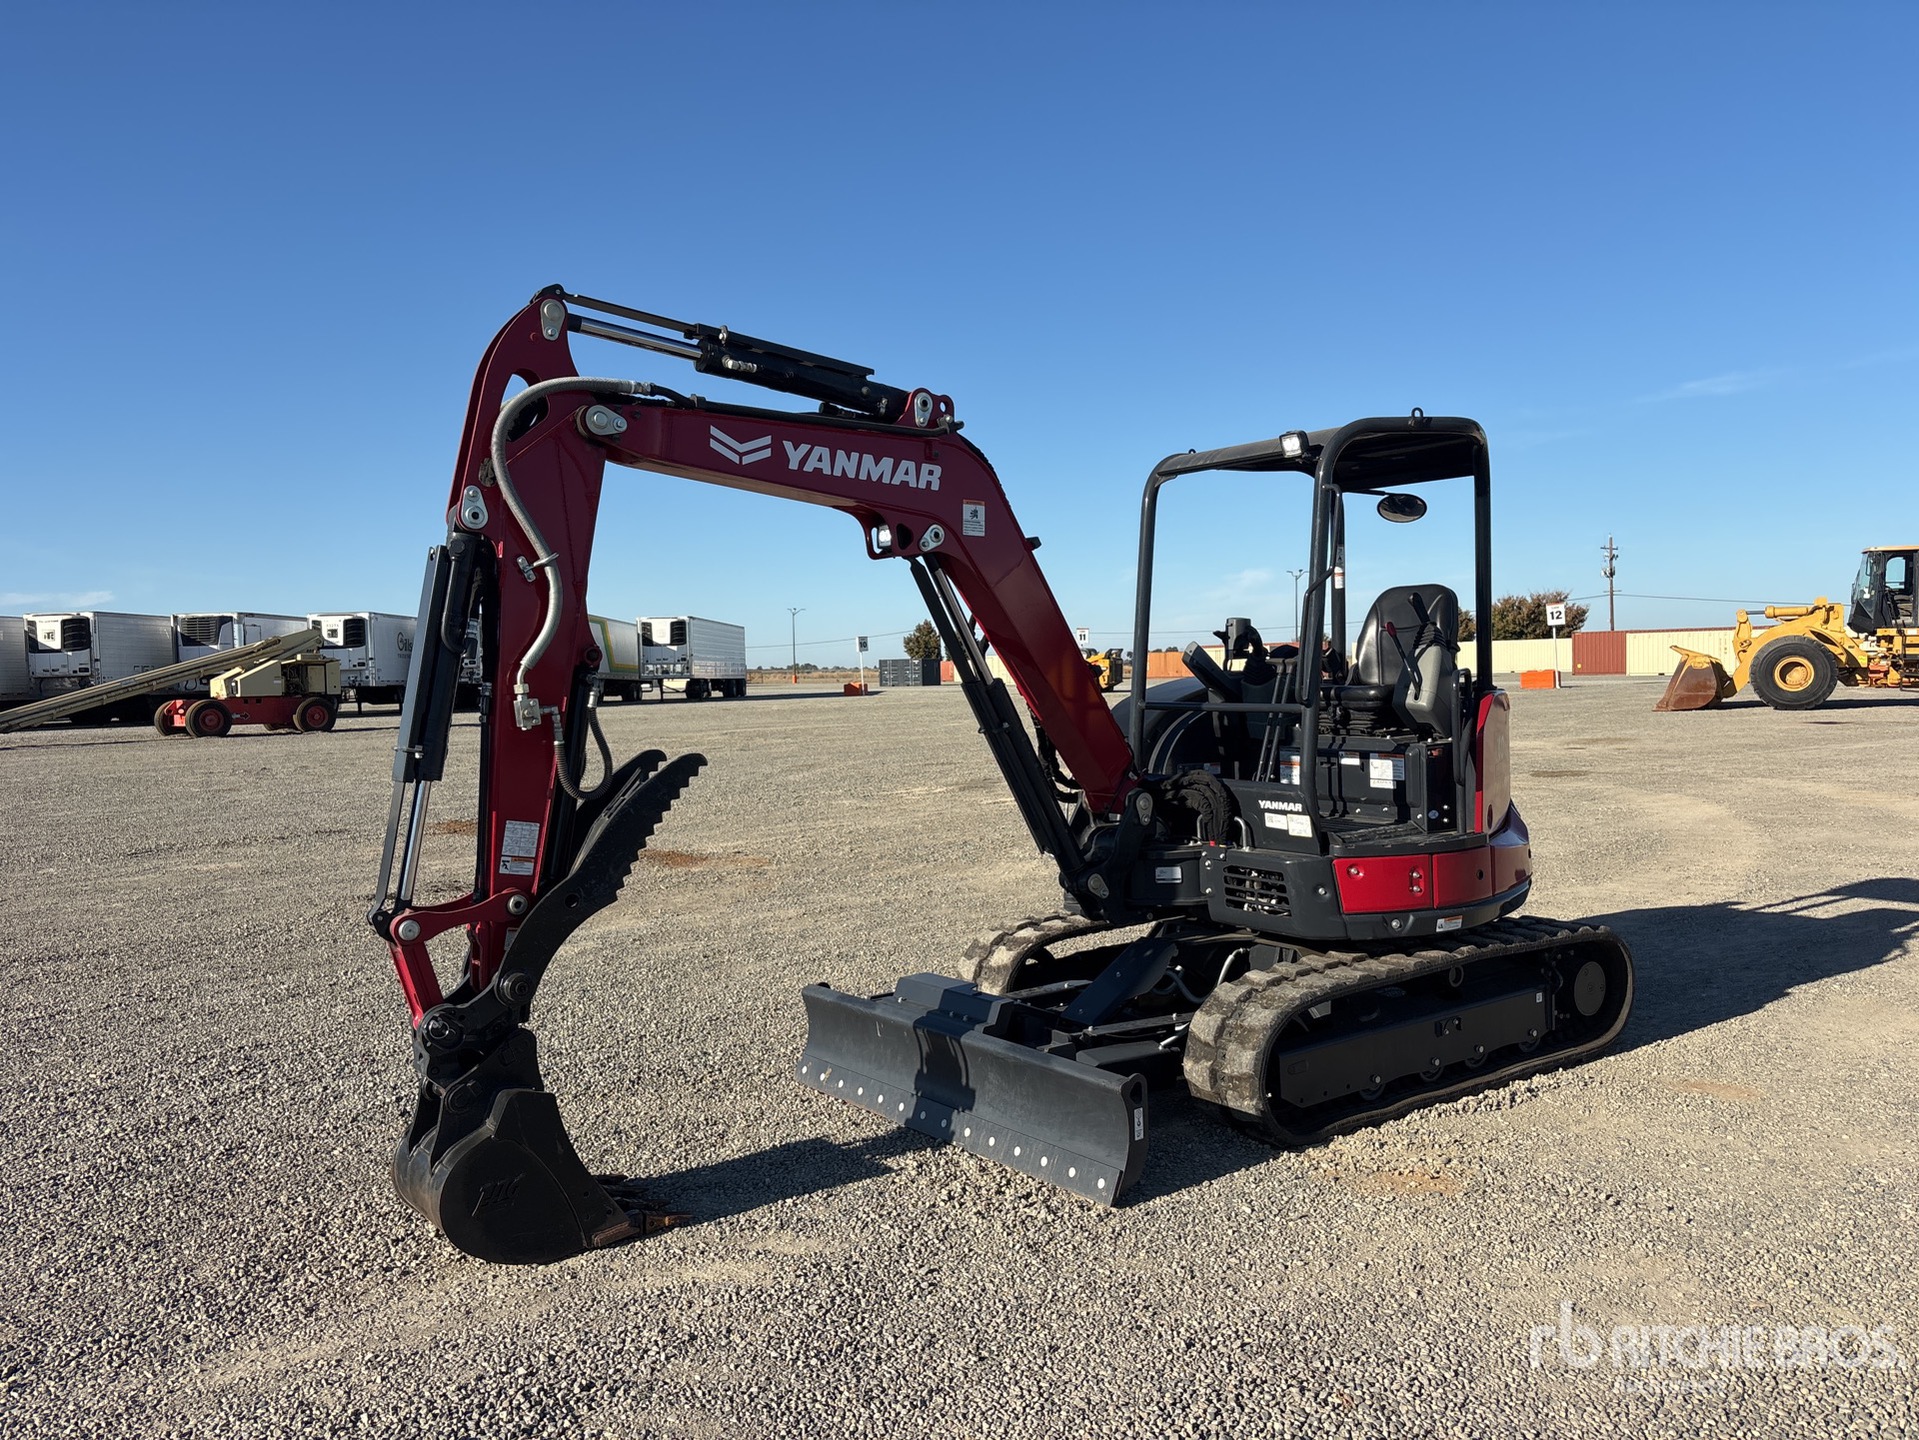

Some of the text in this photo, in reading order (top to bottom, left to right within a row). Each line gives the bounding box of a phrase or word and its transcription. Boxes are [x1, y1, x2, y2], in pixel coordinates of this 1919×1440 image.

[782, 440, 943, 491] YANMAR
[1550, 610, 1562, 620] 12
[1258, 799, 1303, 812] YANMAR
